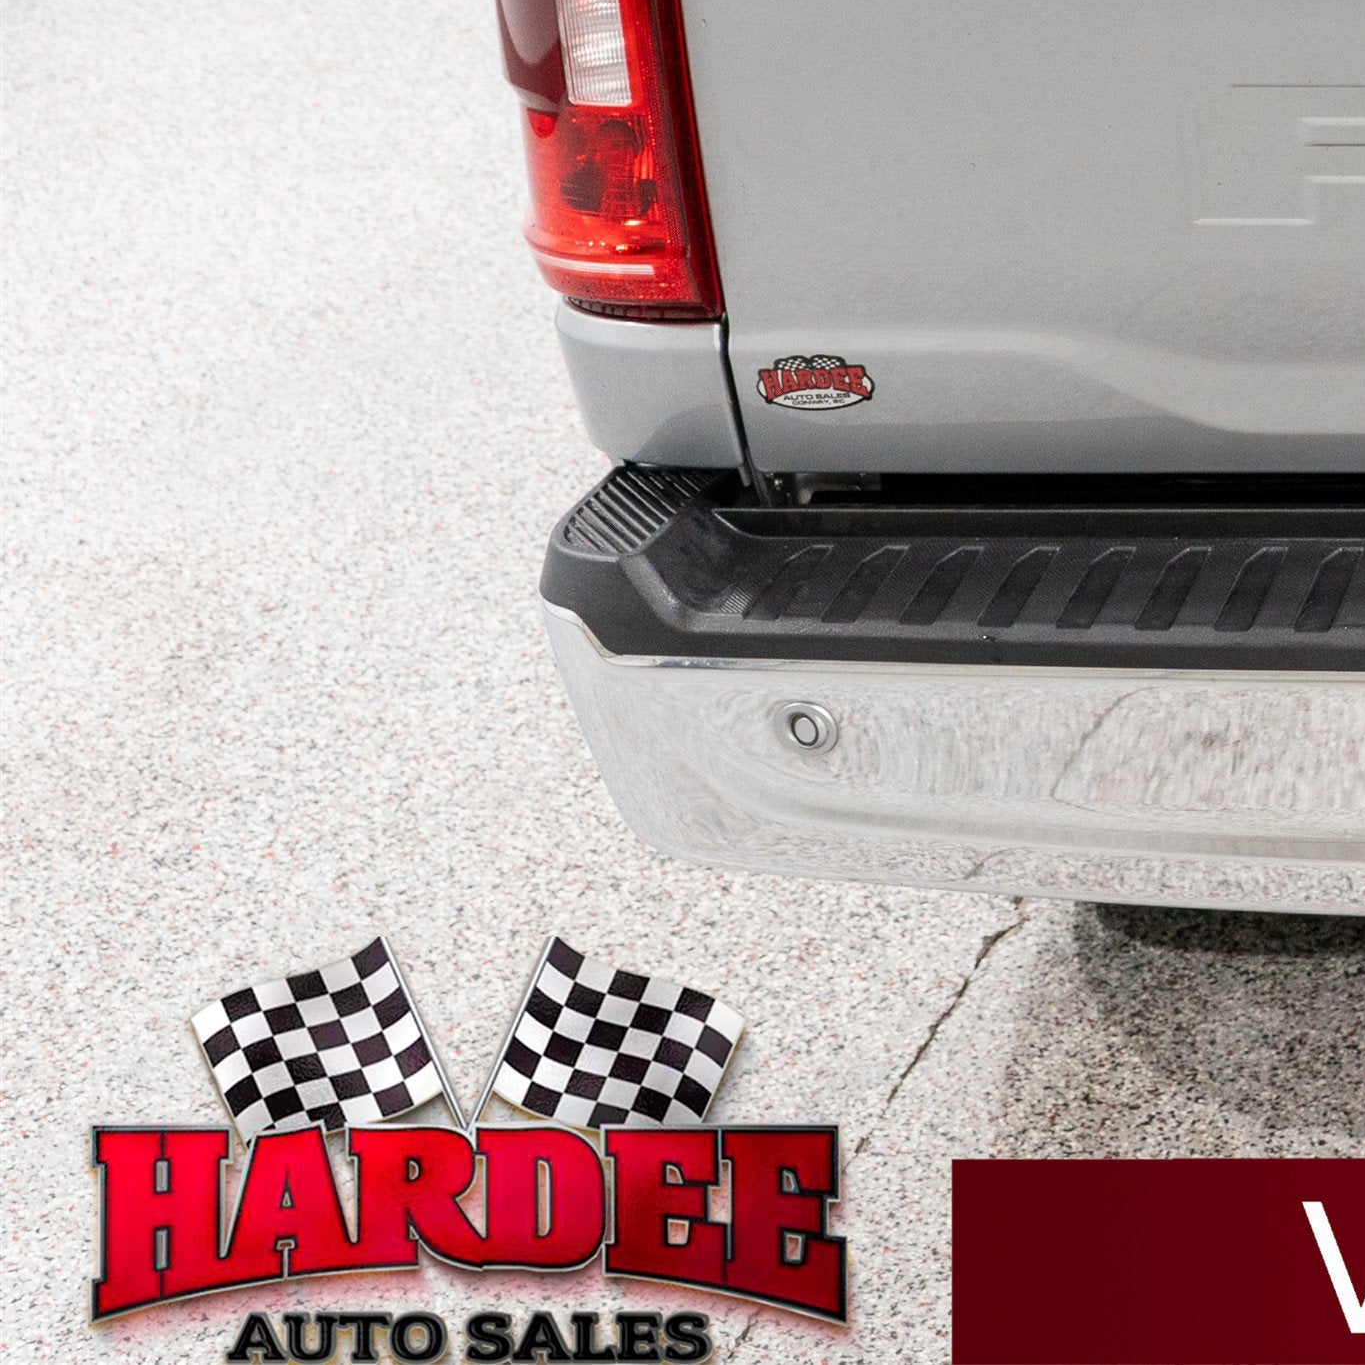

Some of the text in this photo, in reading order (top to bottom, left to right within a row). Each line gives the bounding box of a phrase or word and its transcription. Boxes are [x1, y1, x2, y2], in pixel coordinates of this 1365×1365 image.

[759, 365, 871, 402] HARDEE
[782, 391, 851, 401] AUTO SALES
